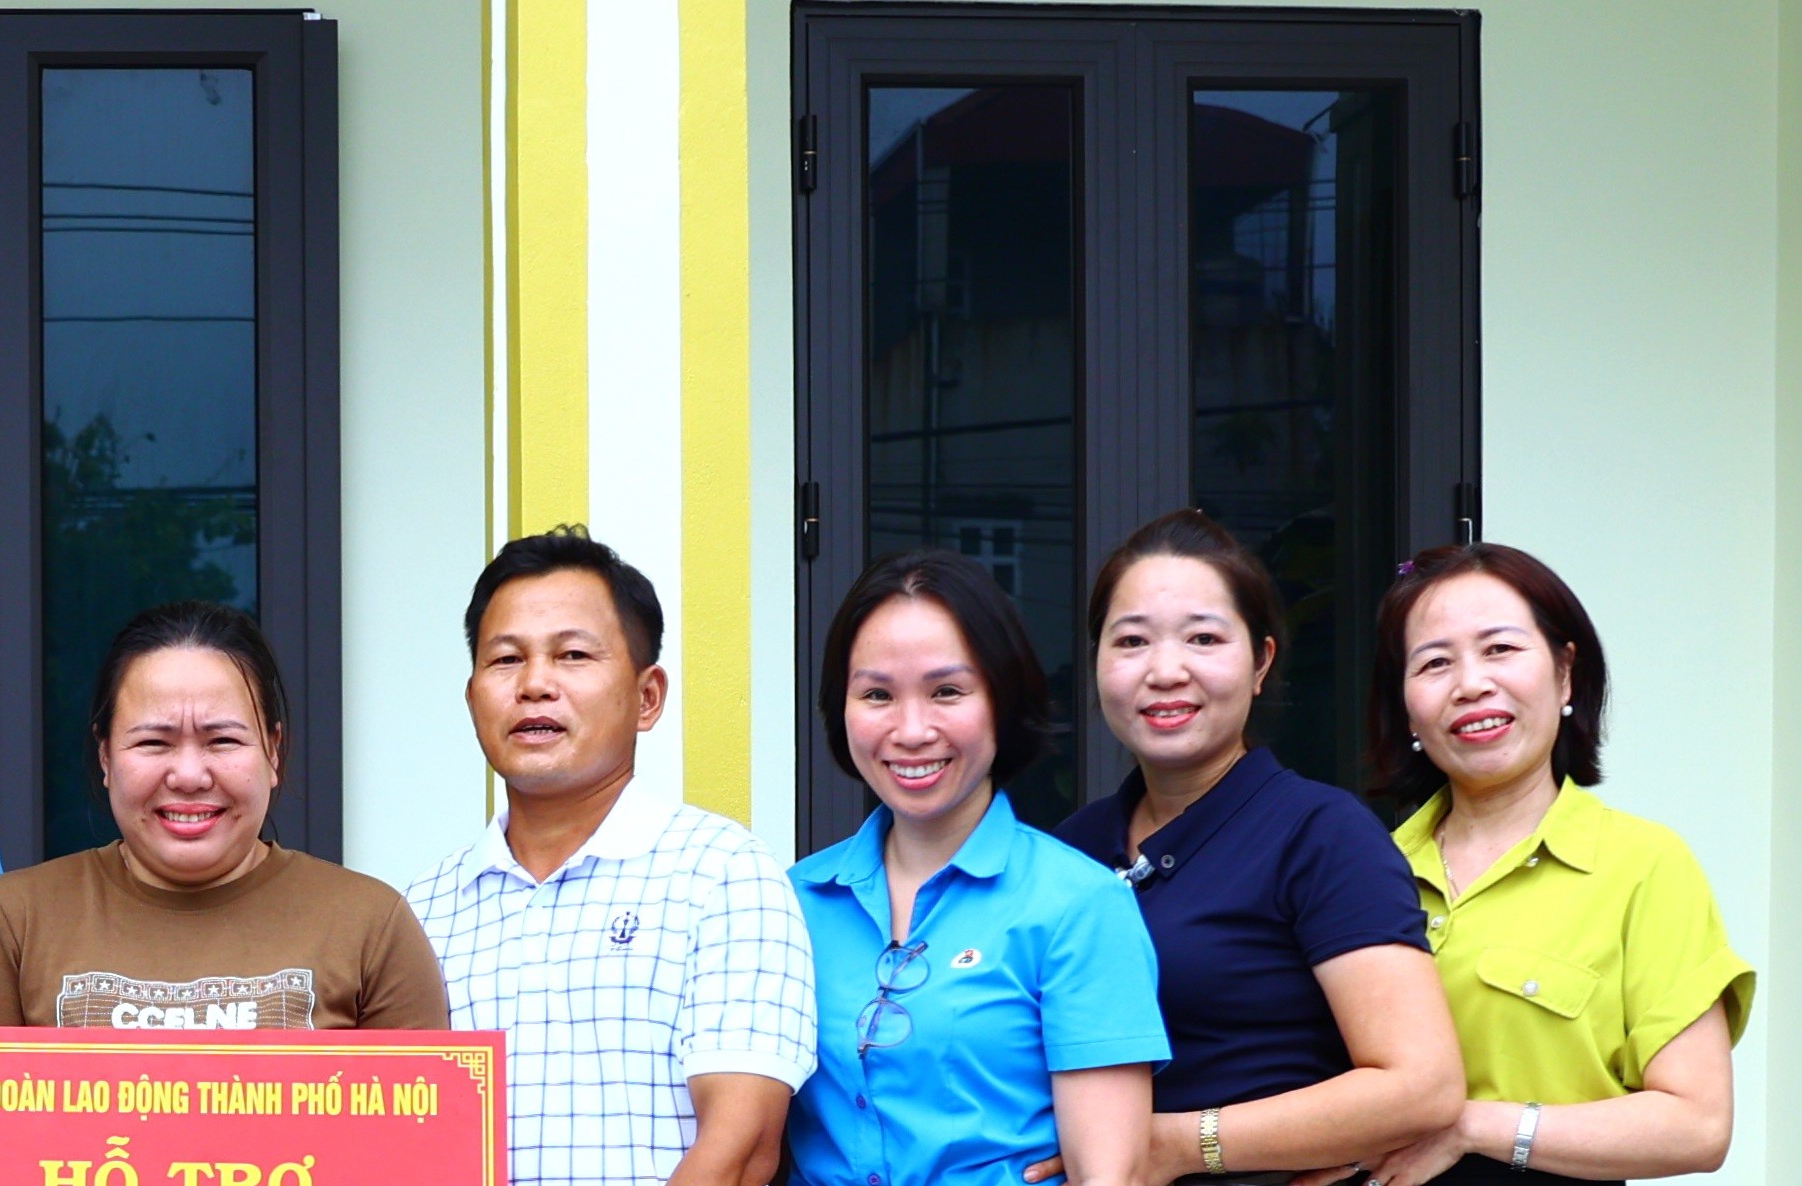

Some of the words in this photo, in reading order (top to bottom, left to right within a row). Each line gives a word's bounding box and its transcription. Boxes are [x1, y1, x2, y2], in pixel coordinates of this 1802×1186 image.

[63, 1080, 110, 1113] LAO
[118, 1074, 190, 1121] ĐỘNG
[197, 1074, 283, 1115] THÀNH
[291, 1071, 344, 1116] PHỐ
[350, 1075, 386, 1116] HÀ
[393, 1076, 438, 1123] NỘI
